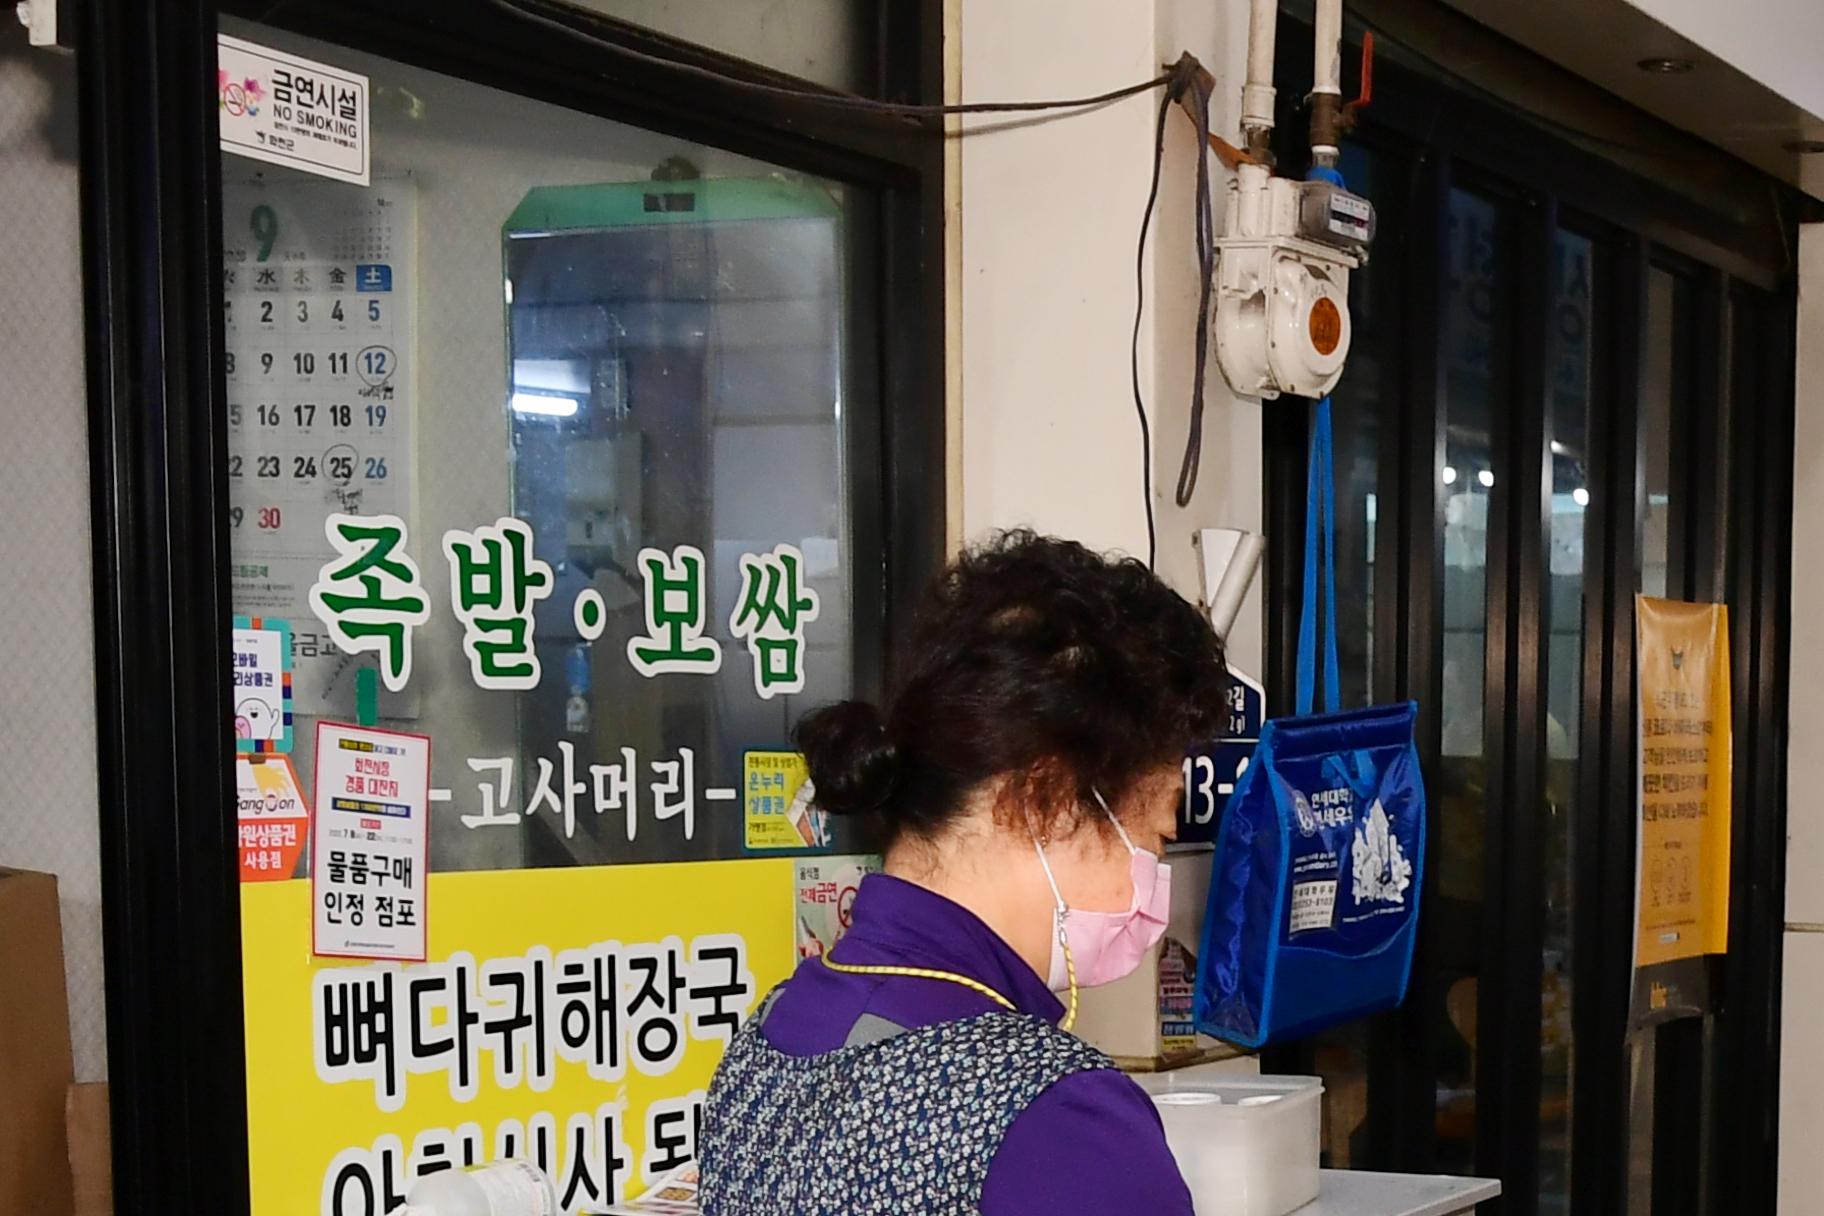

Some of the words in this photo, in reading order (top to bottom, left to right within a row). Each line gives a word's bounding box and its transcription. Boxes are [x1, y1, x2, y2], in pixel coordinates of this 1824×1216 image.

[271, 68, 357, 122] 금연시설
[273, 104, 292, 121] NO
[297, 110, 357, 138] SMOKING
[257, 268, 277, 285] 水
[293, 269, 310, 285] 木
[328, 267, 347, 284] 金
[364, 267, 382, 284] 土
[260, 300, 273, 323] 2
[297, 300, 309, 323] 3
[331, 300, 344, 322] 4
[368, 300, 380, 322] 5
[261, 352, 273, 375] 9
[293, 352, 315, 375] 10
[327, 352, 348, 375] 11
[364, 352, 386, 375] 12
[257, 405, 280, 427] 16
[293, 405, 316, 427] 17
[329, 405, 352, 428] 18
[364, 405, 387, 428] 19
[257, 456, 280, 478] 23
[293, 457, 317, 479] 24
[330, 457, 353, 479] 25
[364, 457, 387, 480] 26
[258, 507, 281, 529] 30
[749, 771, 785, 792] 온누리
[1182, 755, 1250, 825] 13-
[750, 794, 786, 816] 상품권
[244, 850, 282, 870] 사용점
[327, 850, 412, 890] 물품구매
[324, 891, 364, 927] 인정
[375, 895, 416, 928] 점포
[322, 945, 749, 1098] 뼈다귀해장국
